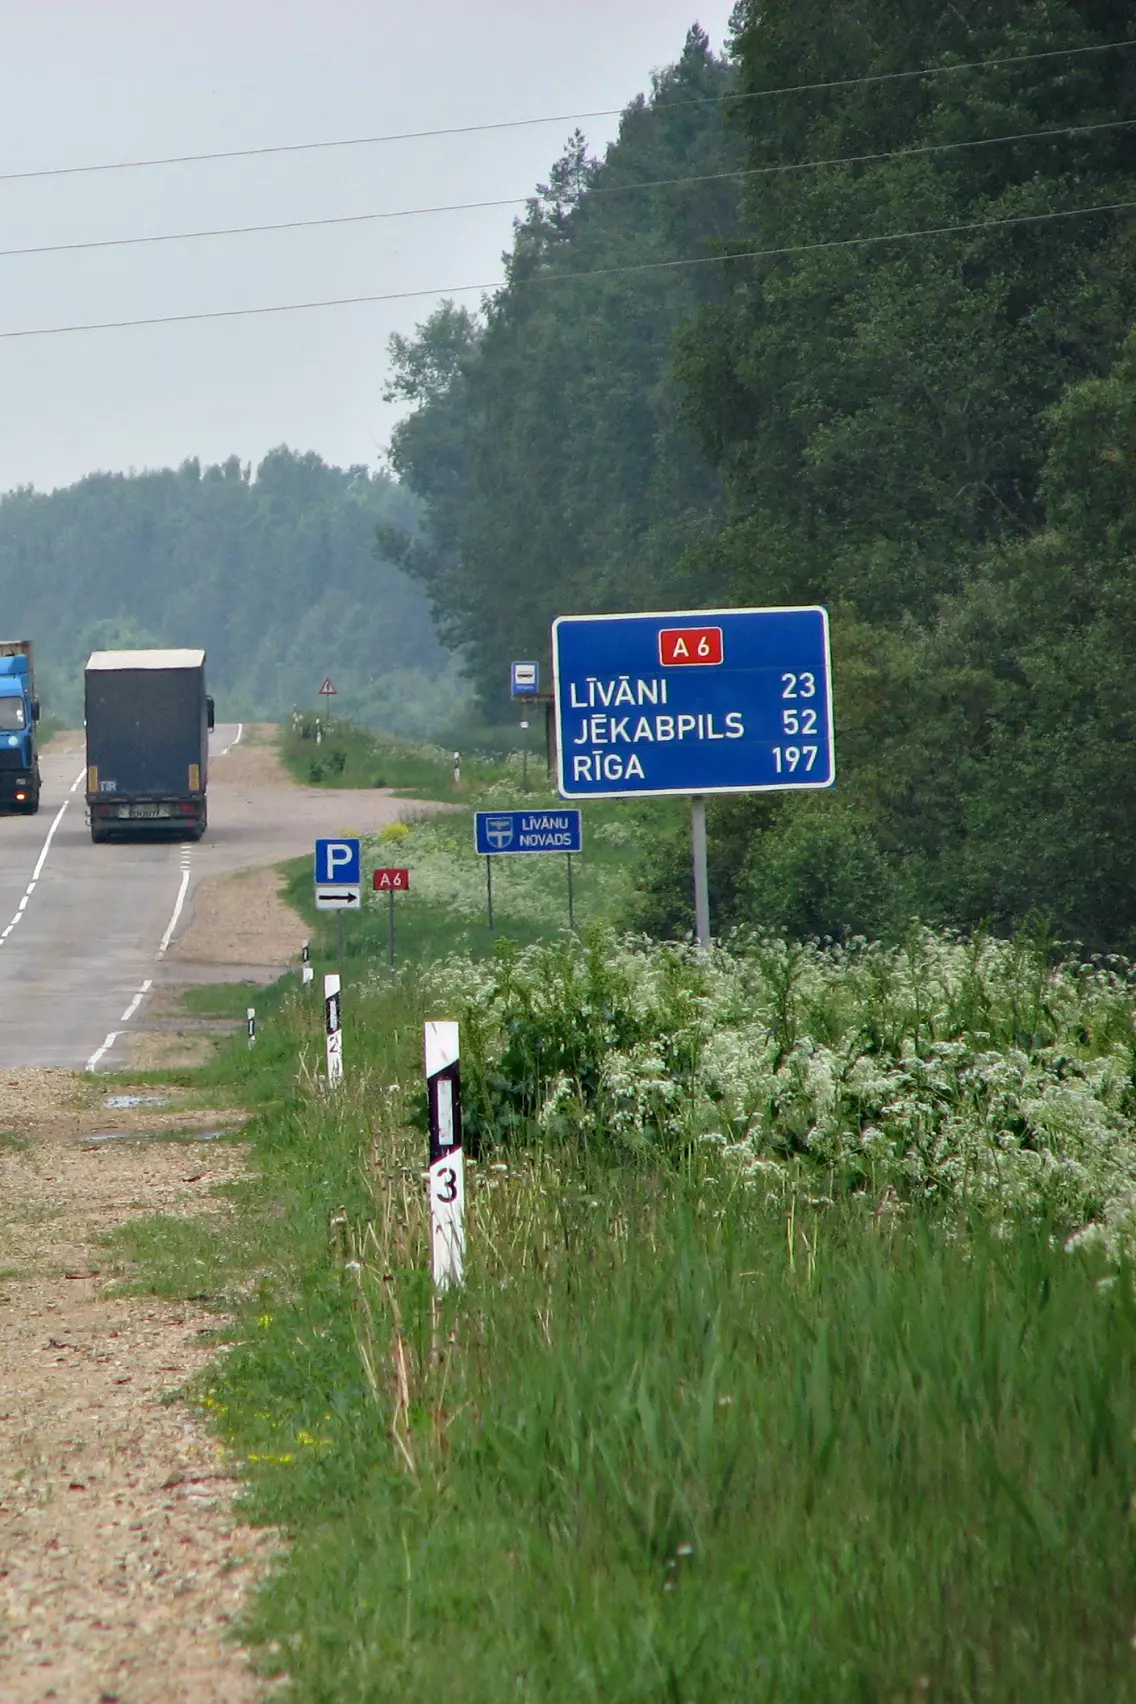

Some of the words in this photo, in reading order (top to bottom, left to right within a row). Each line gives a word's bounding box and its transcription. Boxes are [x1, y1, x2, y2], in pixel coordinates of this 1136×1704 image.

[672, 637, 689, 658] A
[697, 636, 710, 657] 6
[570, 675, 668, 708] LĪVĀNI
[781, 672, 816, 699] 23
[573, 712, 745, 745] JĒKABPILS
[783, 708, 818, 735] 52
[573, 750, 645, 781] RĪGA
[772, 745, 818, 773] 197
[100, 781, 117, 792] TIR
[519, 832, 572, 847] NOVADS
[521, 816, 569, 831] LĪVĀNU
[326, 843, 353, 880] P
[436, 1168, 457, 1203] 3
